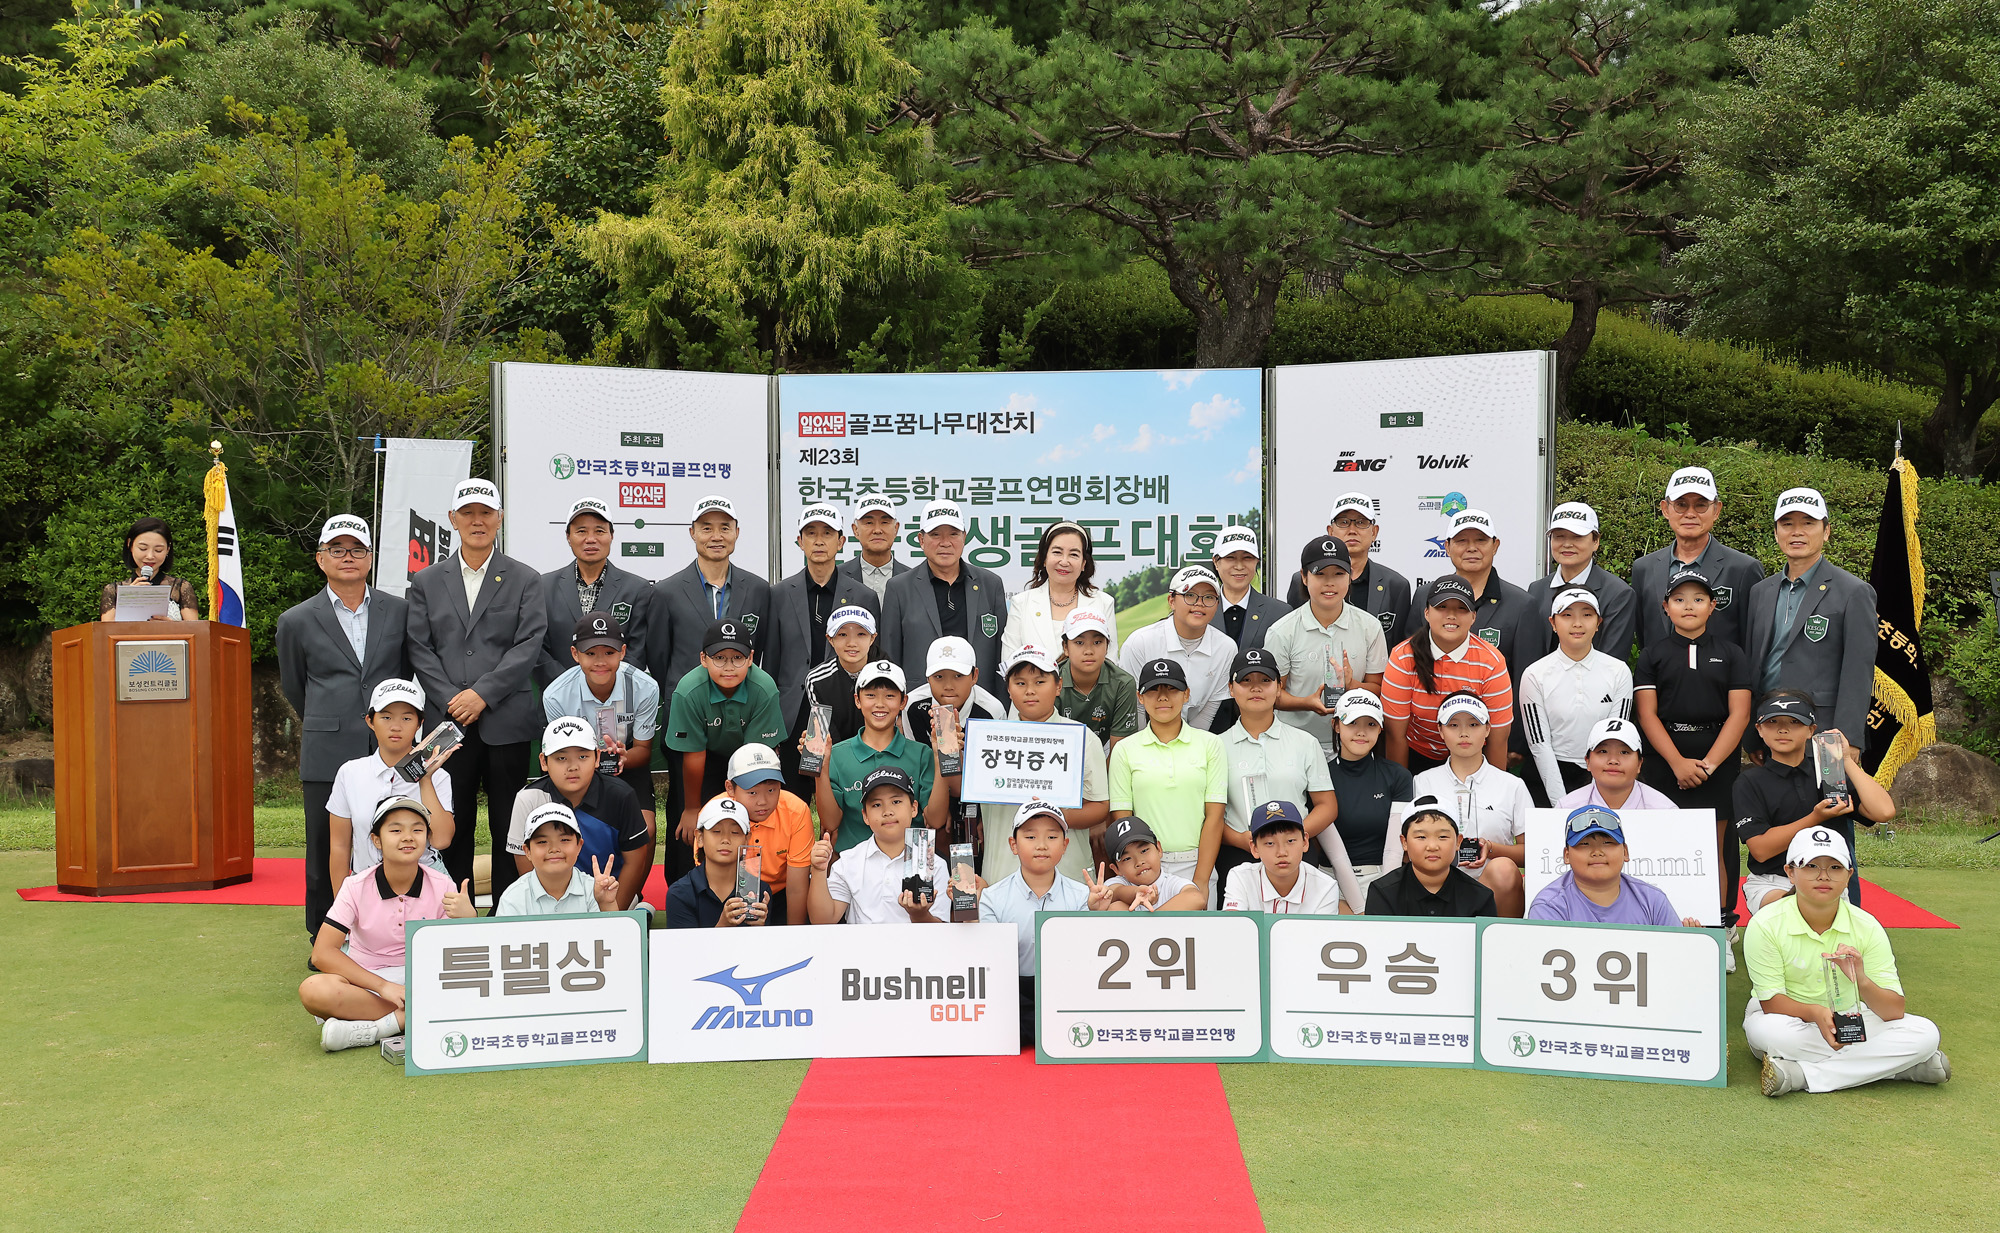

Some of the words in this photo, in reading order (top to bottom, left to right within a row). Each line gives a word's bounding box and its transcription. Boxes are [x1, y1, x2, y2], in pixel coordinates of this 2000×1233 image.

[799, 413, 845, 436] 일요신문
[848, 411, 1035, 435] 골프꿈나무대잔치
[623, 435, 641, 445] 주최
[643, 435, 661, 446] 주관
[799, 448, 859, 467] 제23회
[1417, 454, 1471, 470] Volvik
[576, 458, 732, 480] 한국초등학교골프연맹
[1673, 475, 1711, 488] KESGA
[457, 486, 495, 499] KESGA
[620, 484, 664, 506] 일요신문
[798, 475, 1169, 506] 한국초등학교골프연맹회장배
[572, 500, 607, 512] KESGA
[697, 499, 732, 511] KESGA
[859, 498, 892, 510] KESGA
[1335, 497, 1370, 509] KESGA
[1780, 495, 1820, 508] KESGA
[802, 508, 837, 520] KESGA
[926, 508, 960, 520] KESGA
[1454, 515, 1490, 528] KESGA
[1552, 510, 1588, 523] KESGA
[328, 520, 367, 534] KESGA
[1221, 533, 1256, 546] KESGA
[1434, 580, 1472, 597] Titleist
[831, 608, 870, 622] MEDIHEAL
[1069, 611, 1106, 626] Titleist
[129, 680, 178, 688] 보성컨트리클럽
[378, 683, 418, 697] Titleist
[1344, 696, 1381, 711] Titleist
[1442, 698, 1482, 711] MEDIHEAL
[552, 721, 584, 736] Callaway
[986, 735, 1065, 745] 한국초등학교골프연맹회장배
[981, 749, 1068, 772] 장학증서
[865, 769, 903, 788] Titleist
[531, 810, 572, 824] TaylorMade
[439, 940, 612, 998] 특별상
[1317, 941, 1440, 995] 우승
[841, 967, 986, 1001] Bushnell
[691, 1006, 814, 1031] MIZUNO
[931, 1004, 986, 1022] GOLF
[471, 1029, 617, 1051] 한국초등학교골프연맹
[1096, 1026, 1236, 1045] 한국초등학교골프연맹
[1326, 1029, 1469, 1048] 한국초등학교골프연맹
[1538, 1038, 1692, 1065] 한국초등학교골프연맹
